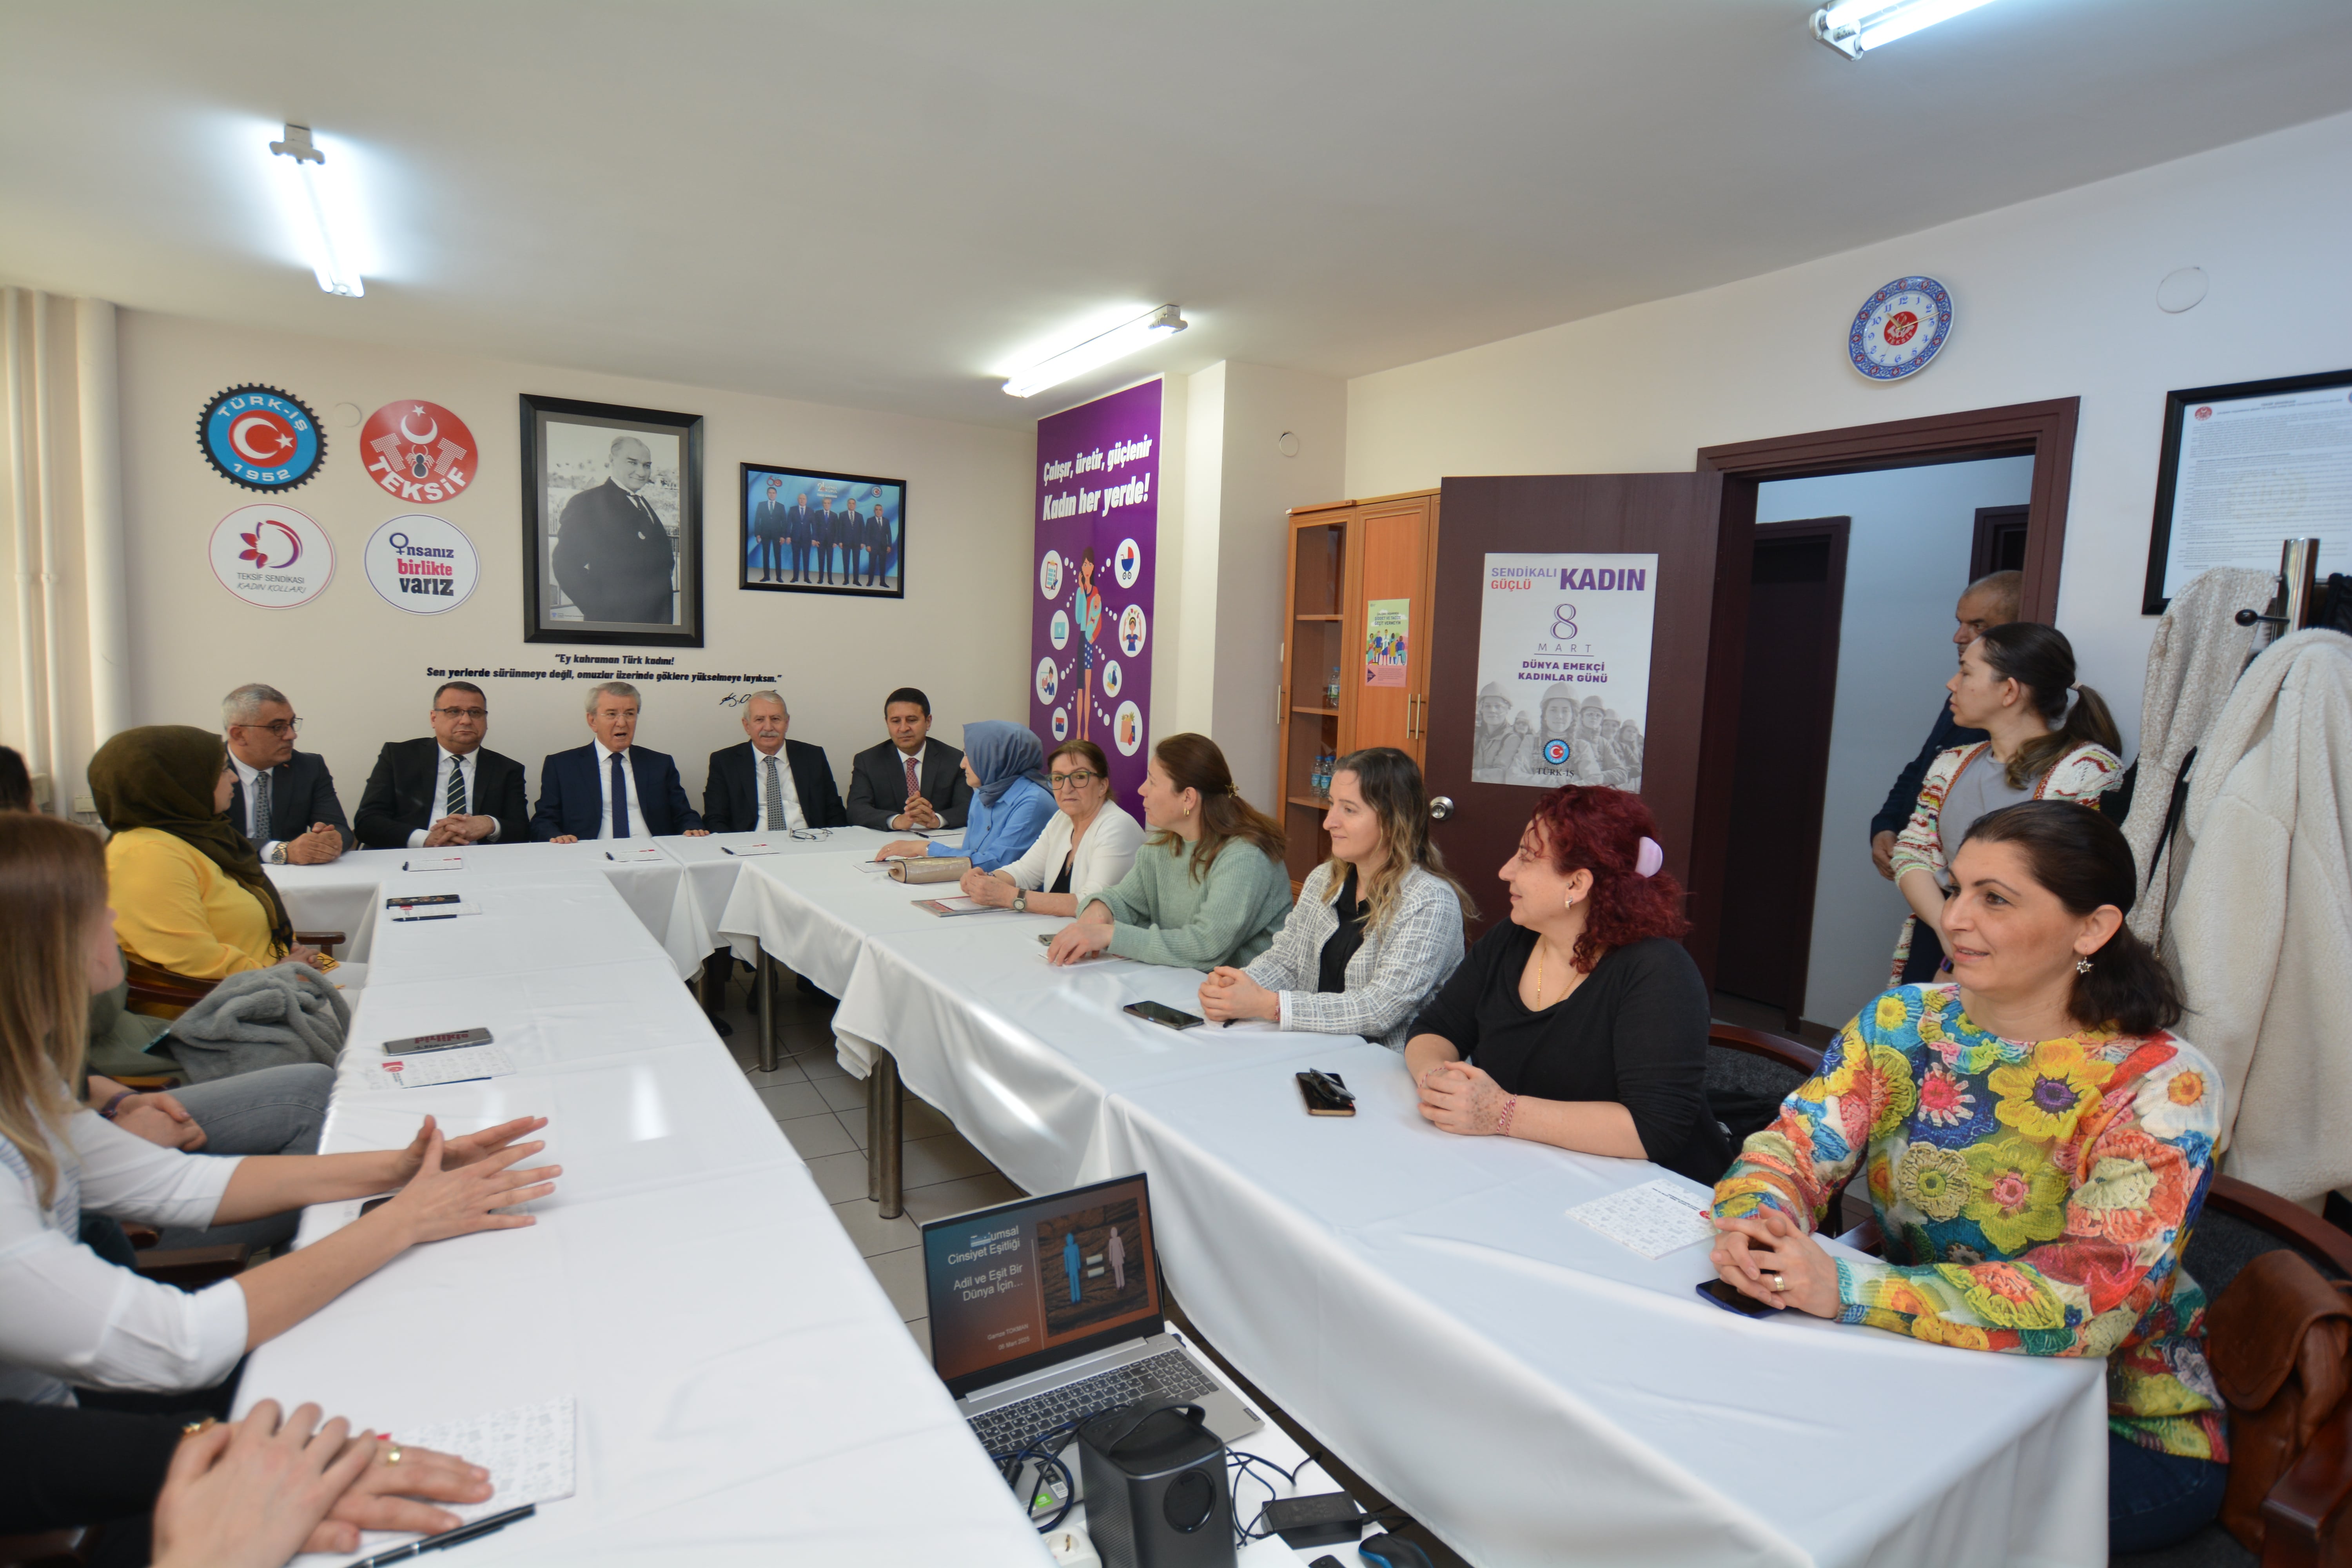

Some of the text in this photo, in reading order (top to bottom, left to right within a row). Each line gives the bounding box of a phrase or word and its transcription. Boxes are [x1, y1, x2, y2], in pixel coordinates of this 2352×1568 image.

[1898, 296, 1908, 305] 12
[1884, 304, 1892, 313] 11
[1926, 304, 1933, 313] 2
[1872, 316, 1882, 326] 10
[1928, 318, 1935, 327] 3
[1868, 332, 1875, 341] 9
[1922, 334, 1929, 343] 4
[1870, 345, 1877, 354] 8
[1911, 347, 1918, 356] 5
[1880, 354, 1886, 363] 7
[1895, 354, 1901, 363] 6
[218, 396, 308, 431] TÜRK-İŞ
[1043, 434, 1152, 486] Çalışır, üretir, güçlenir
[234, 463, 291, 481] 1952
[368, 456, 466, 502] TEKSİF
[1043, 472, 1151, 521] Kadın her yerde!
[397, 558, 452, 576] birlikte
[1491, 566, 1557, 578] SENDİKALI
[237, 572, 305, 584] TEKSİF SENDİKASI
[1560, 568, 1646, 591] KADIN
[267, 584, 307, 593] KOLLARI
[399, 578, 454, 596] varız
[1491, 579, 1531, 592] GÜÇLÜ
[1550, 603, 1578, 640] 8
[1538, 643, 1592, 653] MART
[573, 654, 620, 664] kahraman
[622, 655, 643, 664] Türk
[645, 656, 675, 665] kadını!
[1522, 659, 1606, 673] DÜNYA EMEKÇİ
[426, 667, 445, 677] Sen
[448, 668, 490, 679] yerlerde
[493, 668, 547, 680] sürünmeye
[549, 670, 574, 681] değil,
[577, 670, 614, 679] omuzlar
[616, 670, 654, 680] üzerinde
[656, 671, 689, 682] göklere
[691, 672, 742, 684] yükselmeye
[1518, 672, 1608, 683] KADINLAR GÜNÜ
[1536, 766, 1575, 779] TÜRK-İŞ
[948, 1238, 1020, 1265] Cinsiyet Eşitliği
[953, 1264, 1023, 1290] Adil ve Eşit Bir
[963, 1285, 995, 1301] Dünya
[1006, 1340, 1017, 1348] Mart
